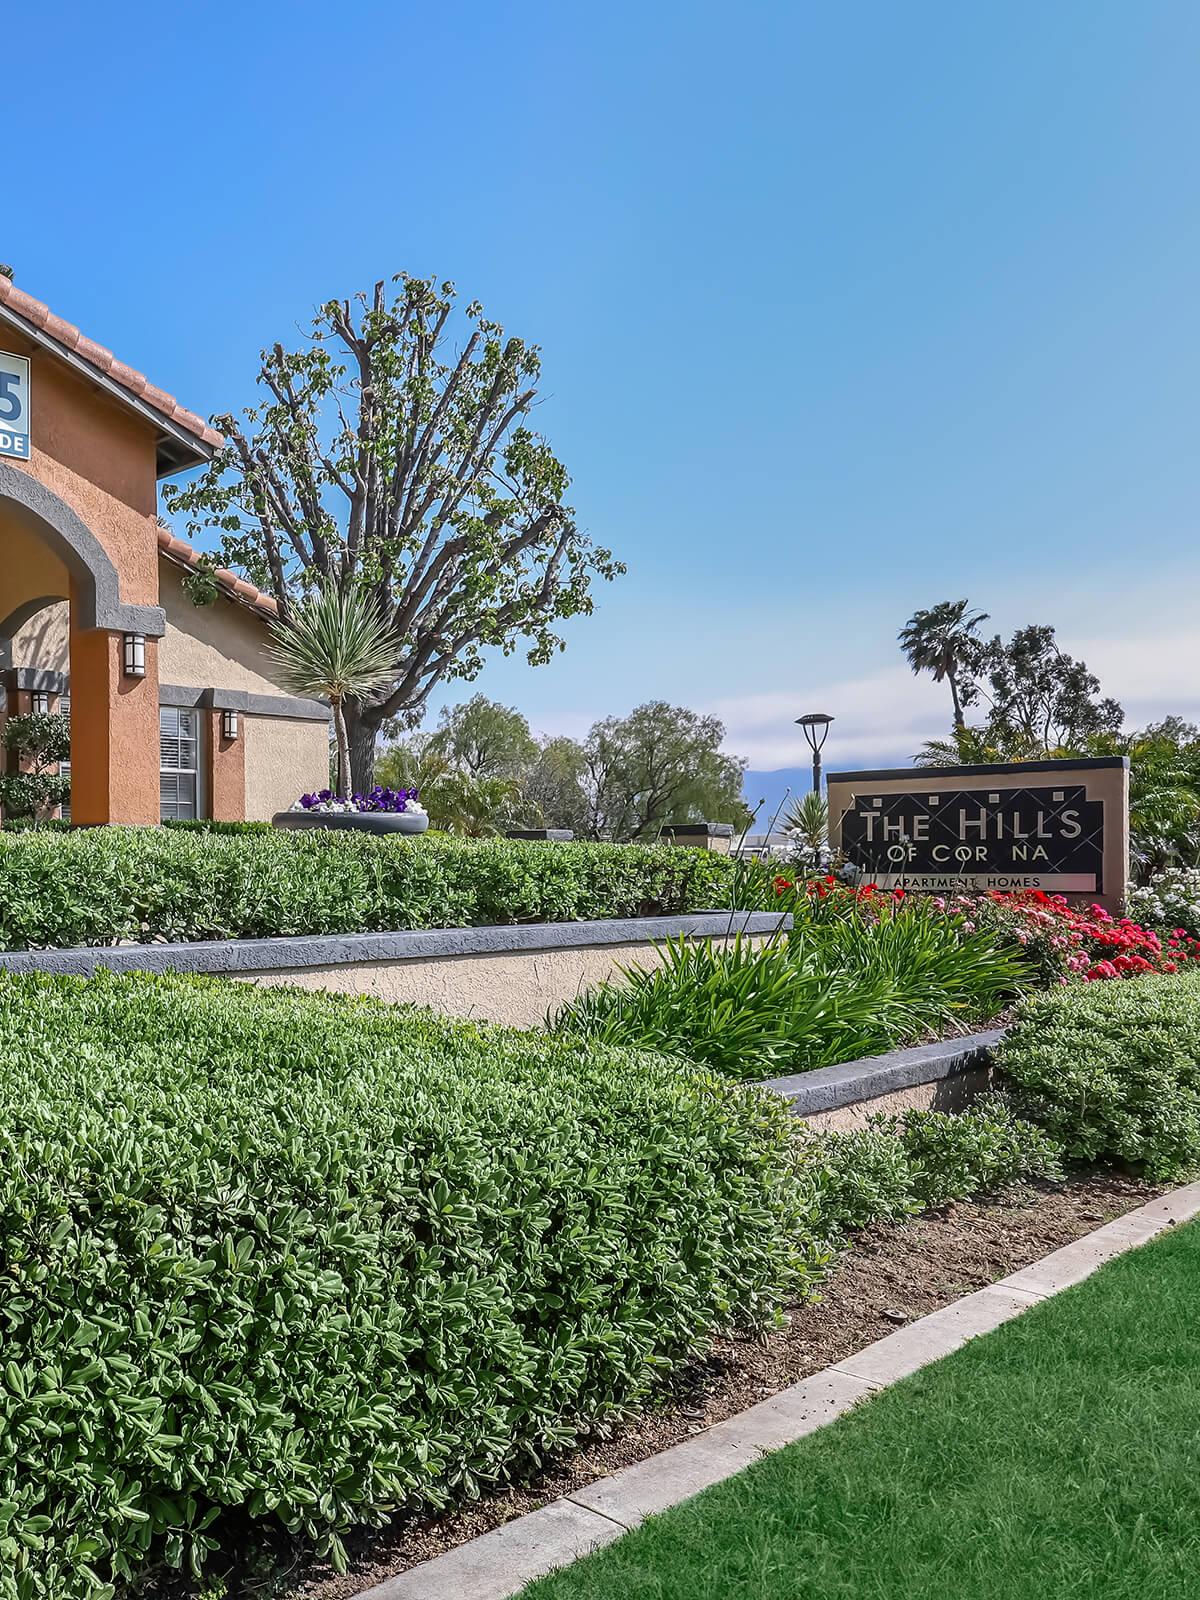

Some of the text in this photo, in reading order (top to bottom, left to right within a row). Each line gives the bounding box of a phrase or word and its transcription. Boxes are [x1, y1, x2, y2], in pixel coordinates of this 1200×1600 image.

[887, 845, 917, 862] OF
[894, 877, 1041, 888] APARTMENT HOMES
